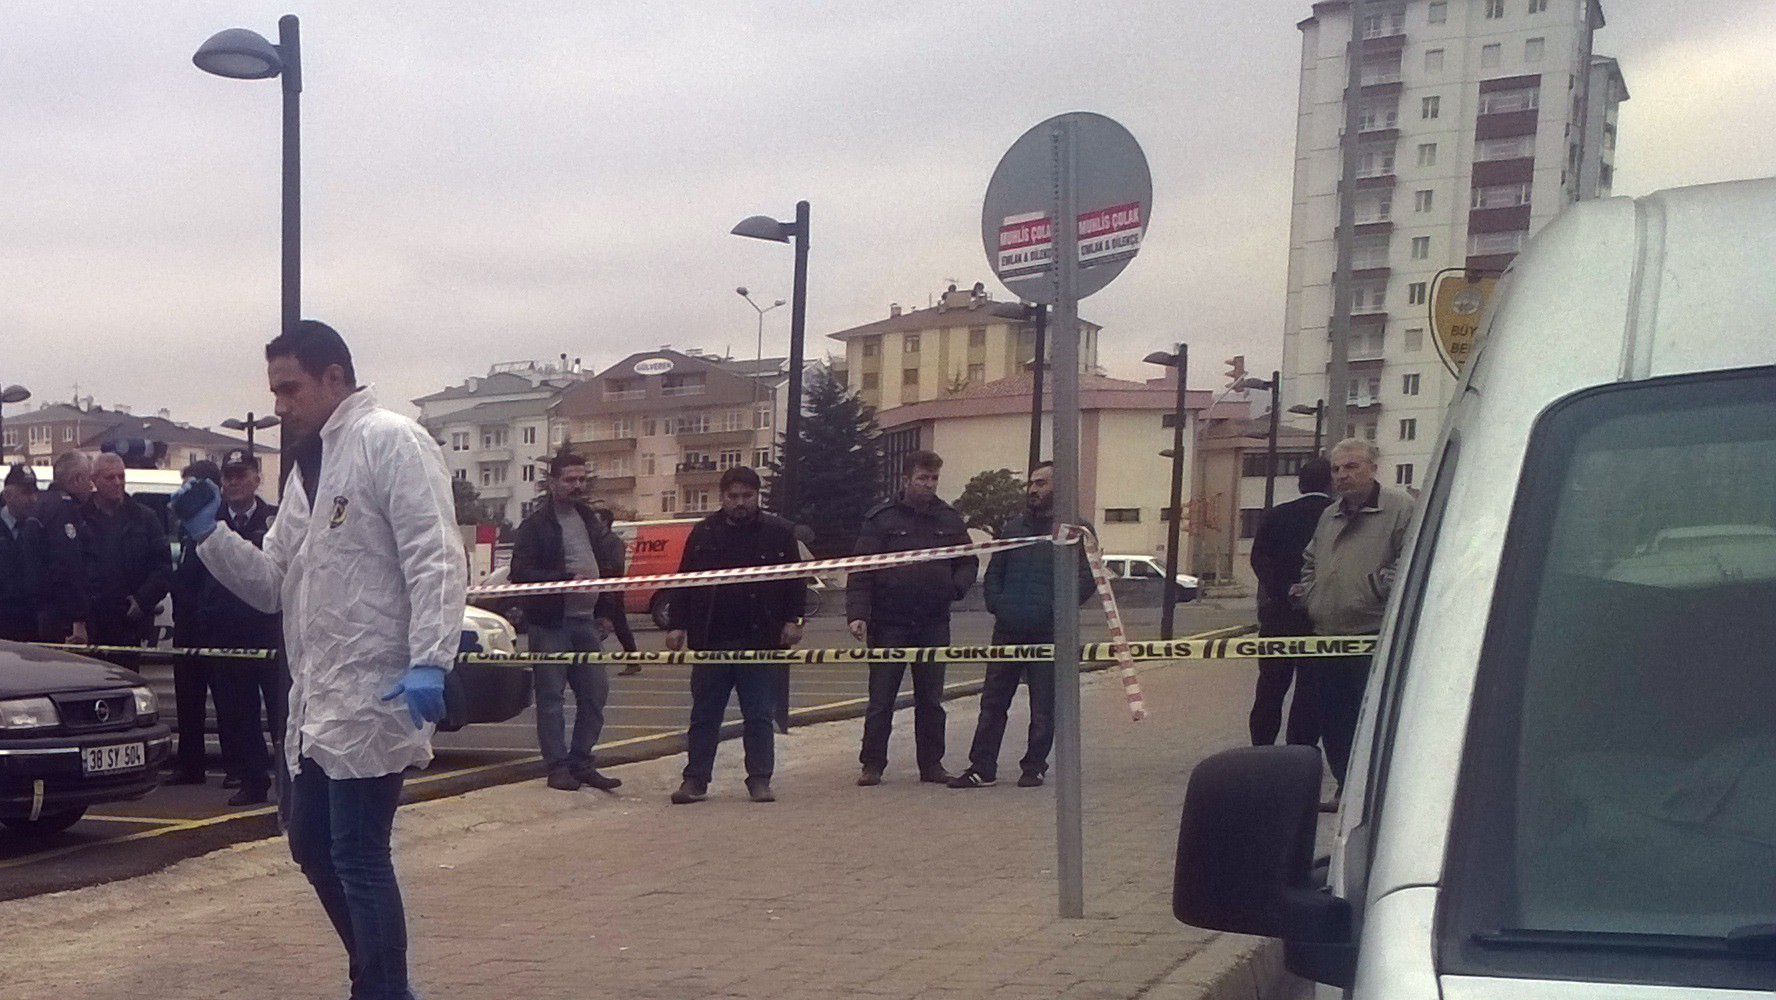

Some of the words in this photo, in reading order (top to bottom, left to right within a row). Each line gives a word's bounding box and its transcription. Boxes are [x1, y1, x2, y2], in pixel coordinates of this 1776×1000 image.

[89, 749, 103, 770] 38
[107, 748, 120, 768] SY
[124, 745, 141, 766] 504
